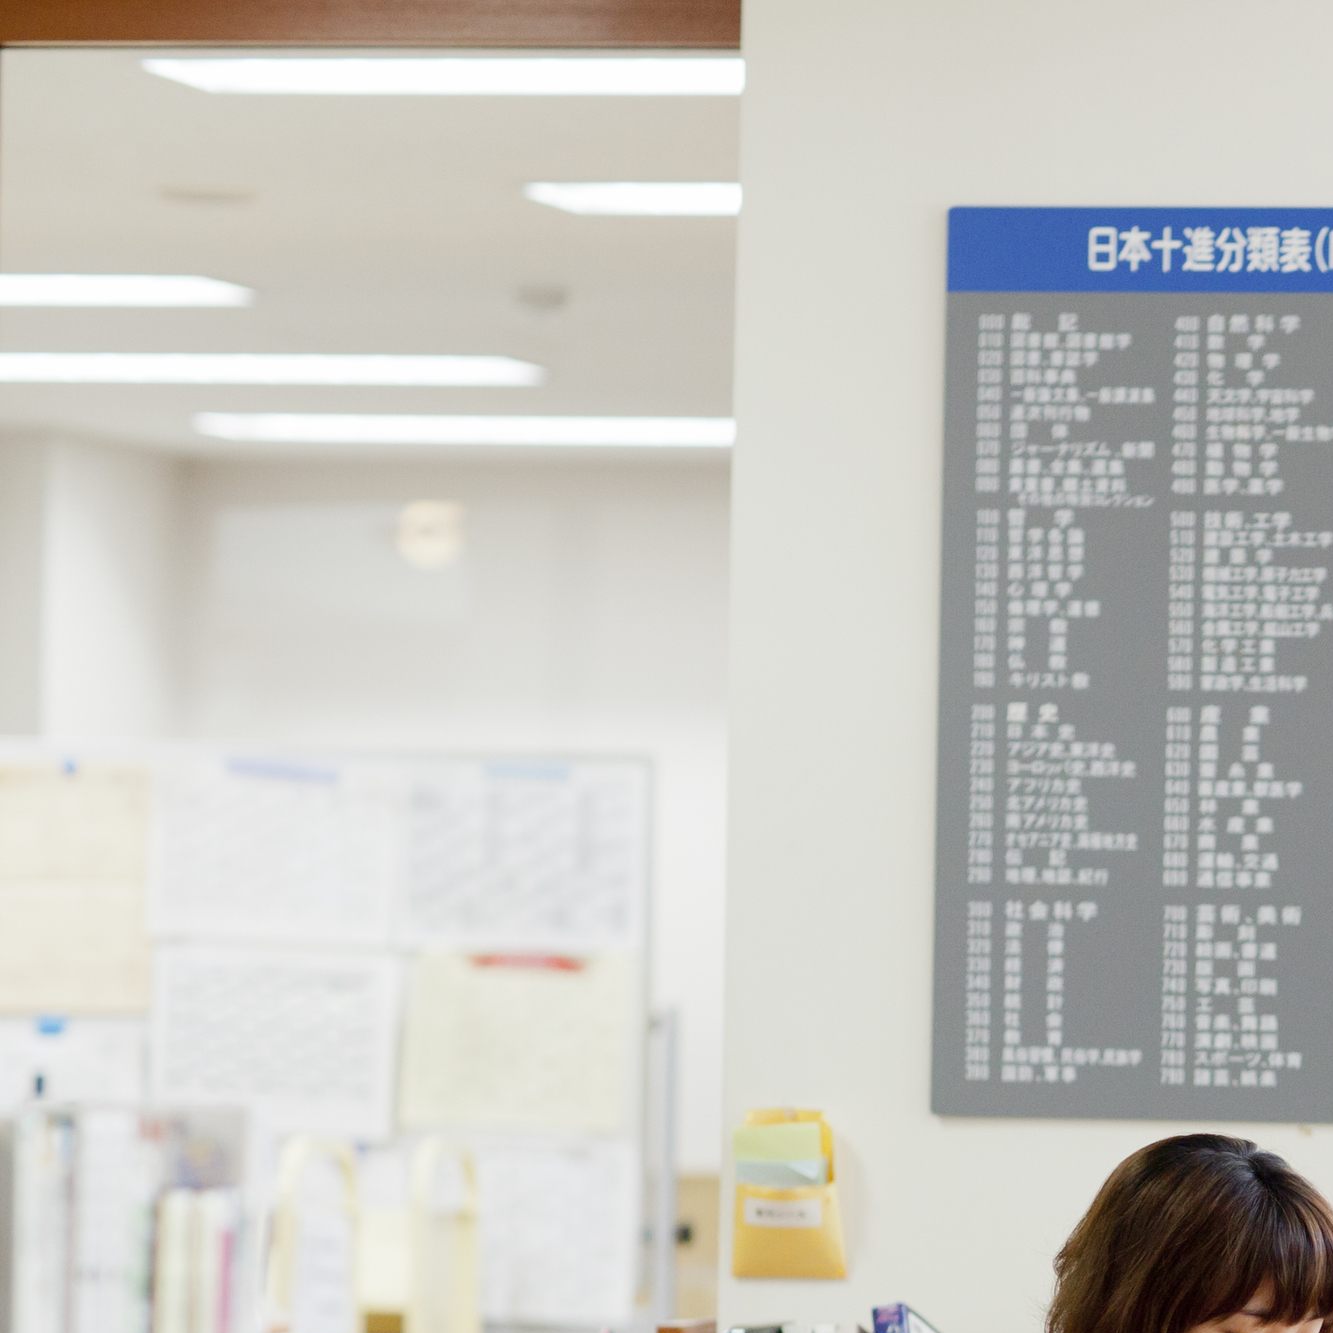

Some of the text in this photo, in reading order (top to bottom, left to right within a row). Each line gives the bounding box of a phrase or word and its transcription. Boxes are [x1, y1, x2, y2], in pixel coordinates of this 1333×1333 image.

[1003, 779, 1081, 792] アフリカ史
